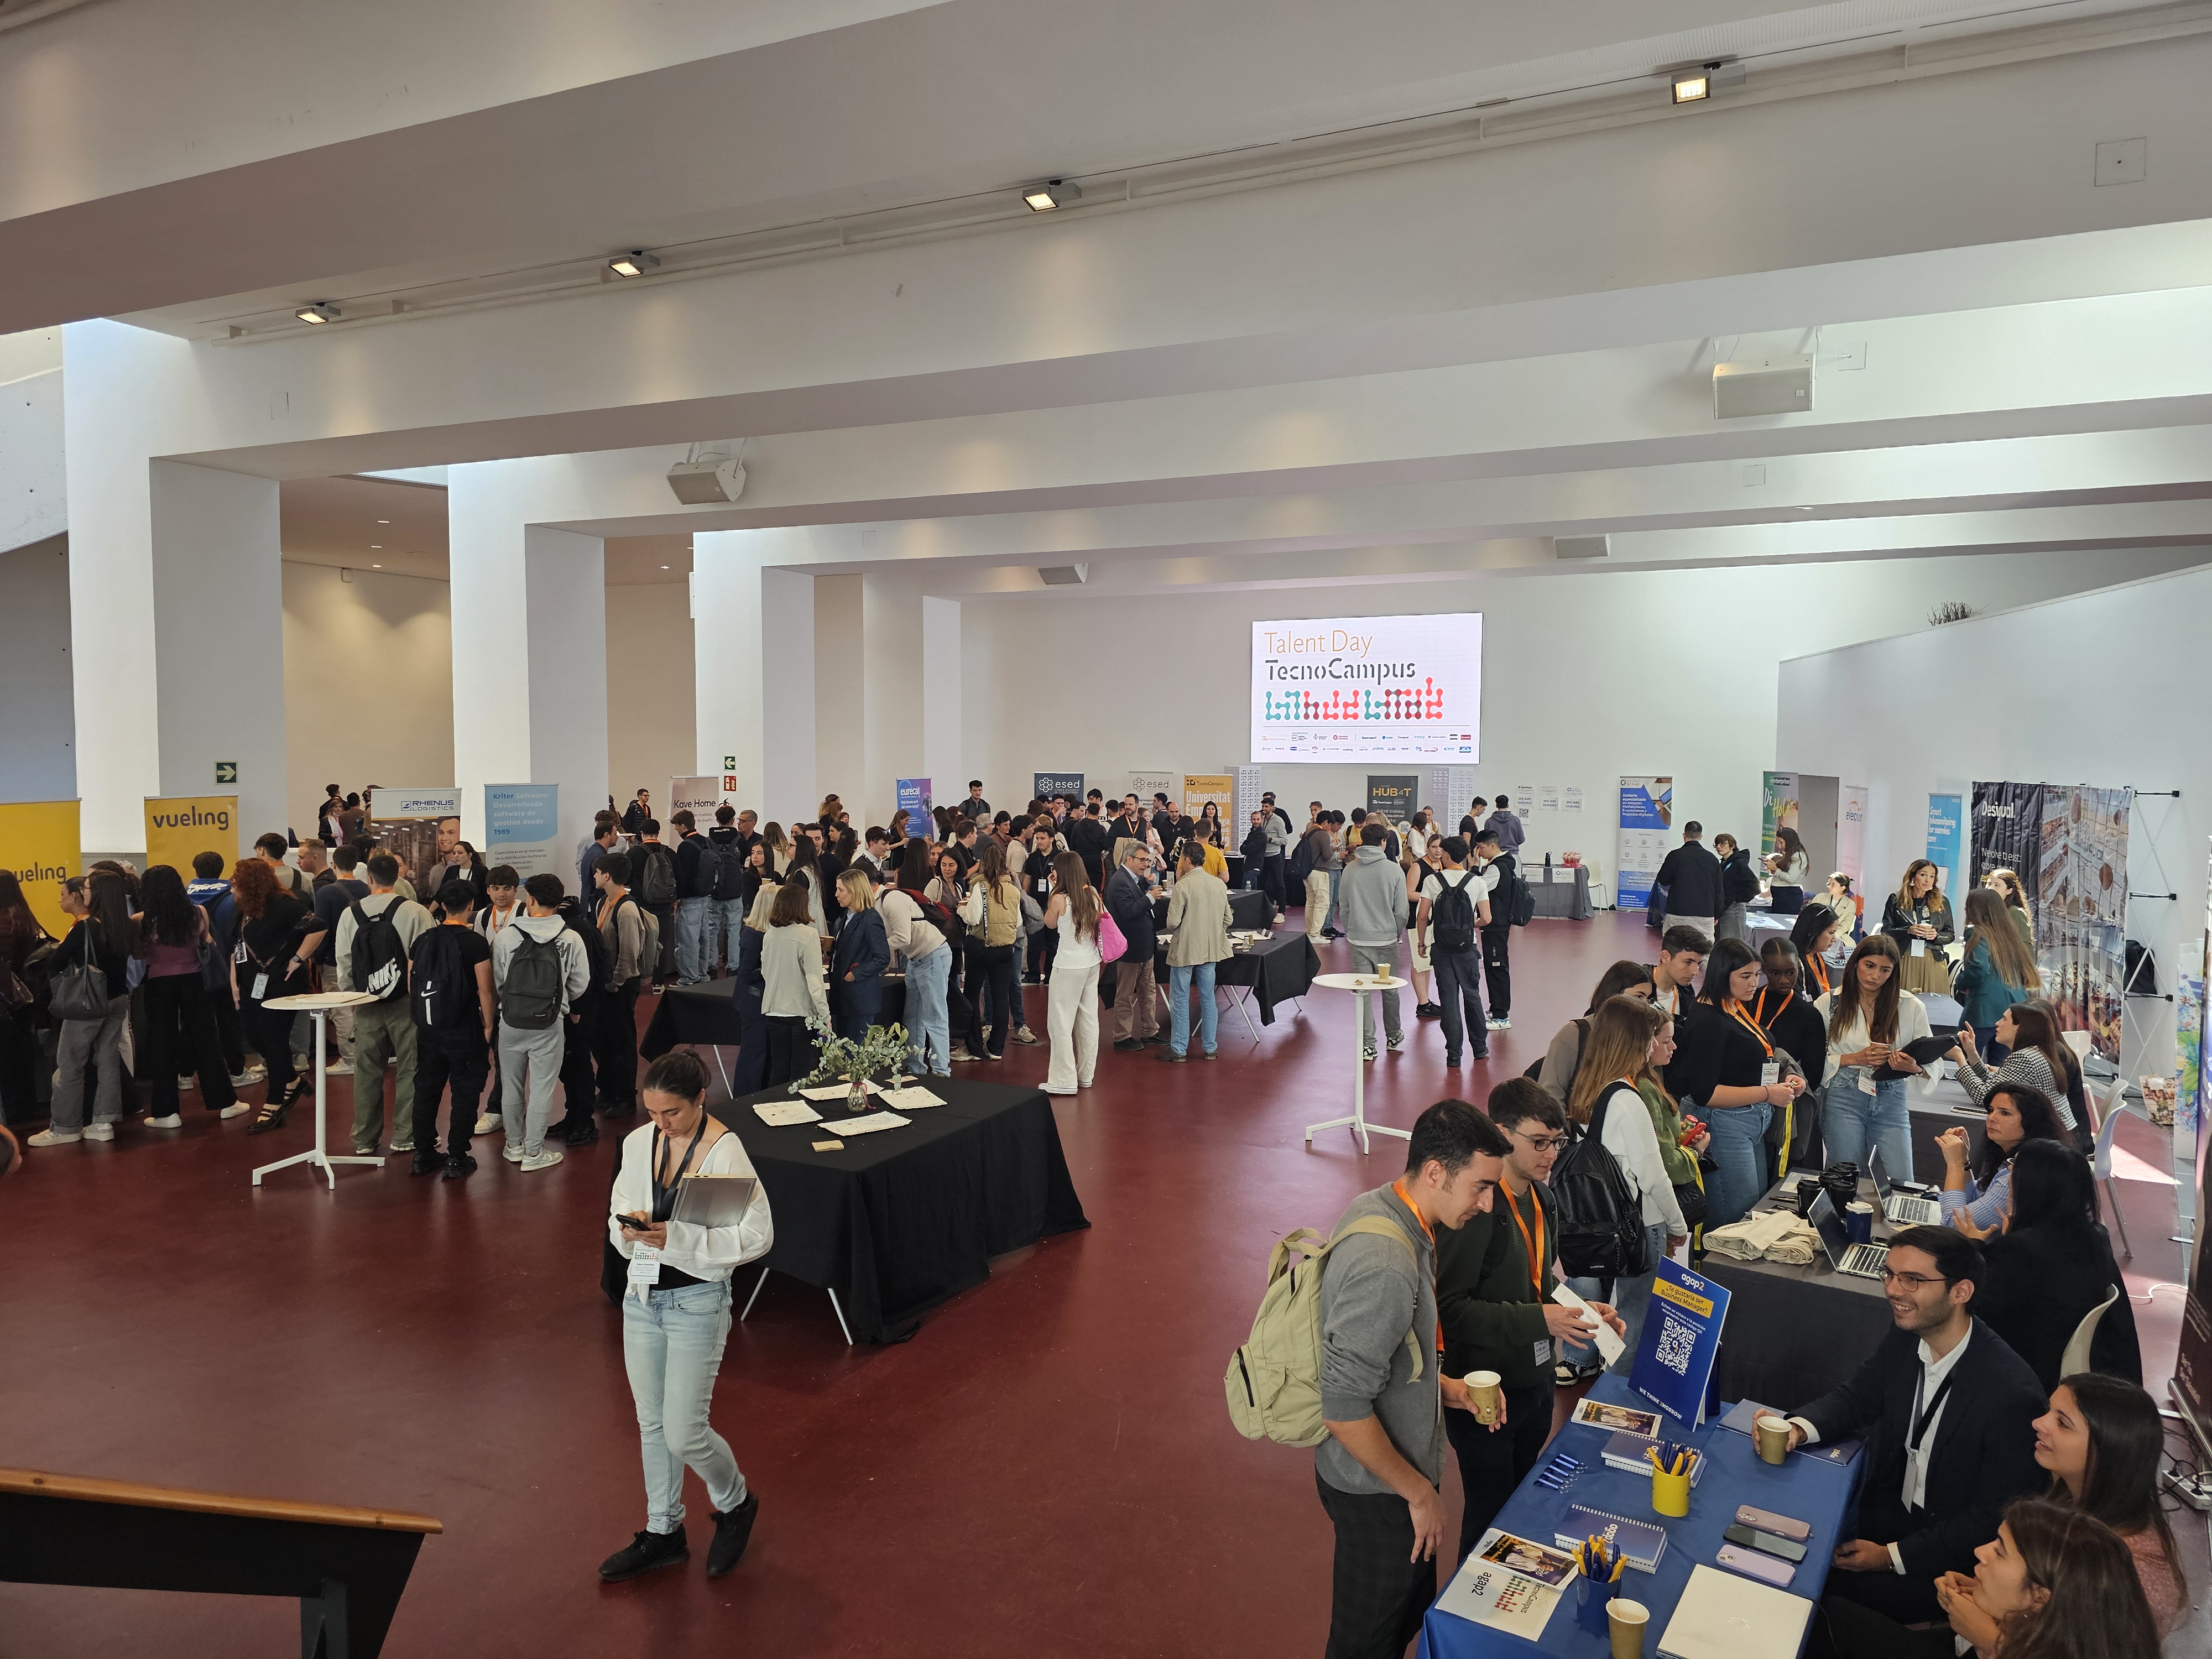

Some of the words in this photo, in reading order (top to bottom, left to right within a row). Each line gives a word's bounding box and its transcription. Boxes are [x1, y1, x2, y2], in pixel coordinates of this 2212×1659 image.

[1265, 631, 1326, 654] Talent
[1332, 630, 1373, 658] Day
[1265, 658, 1416, 685] TecnoCampus
[900, 786, 920, 796] eurecat
[1055, 780, 1079, 789] esed
[1147, 780, 1169, 788] esed
[674, 800, 692, 808] Kave
[694, 799, 716, 807] Home
[1186, 791, 1231, 803] Universitat
[1764, 787, 1773, 808] Di
[153, 805, 229, 831] vueling
[1186, 804, 1222, 818] Empa
[1846, 809, 1863, 822] elecnor
[1930, 806, 1942, 816] Smart
[494, 818, 521, 827] gestión
[1929, 816, 1956, 828] telemonitoring
[1934, 826, 1950, 835] seamless
[12, 862, 66, 884] ueling
[368, 957, 399, 992] NIKE
[1681, 1274, 1704, 1291] agap2
[1661, 1289, 1682, 1303] Business
[1682, 1298, 1708, 1314] Manager?
[1662, 1308, 1679, 1321] escaneando
[1639, 1386, 1647, 1395] WE
[1647, 1392, 1660, 1405] THINK
[1659, 1401, 1683, 1420] 2MORROW
[1602, 1524, 1618, 1544] agap2
[1472, 1572, 1492, 1596] agap2
[1521, 1583, 1545, 1613] TecnoCampus
